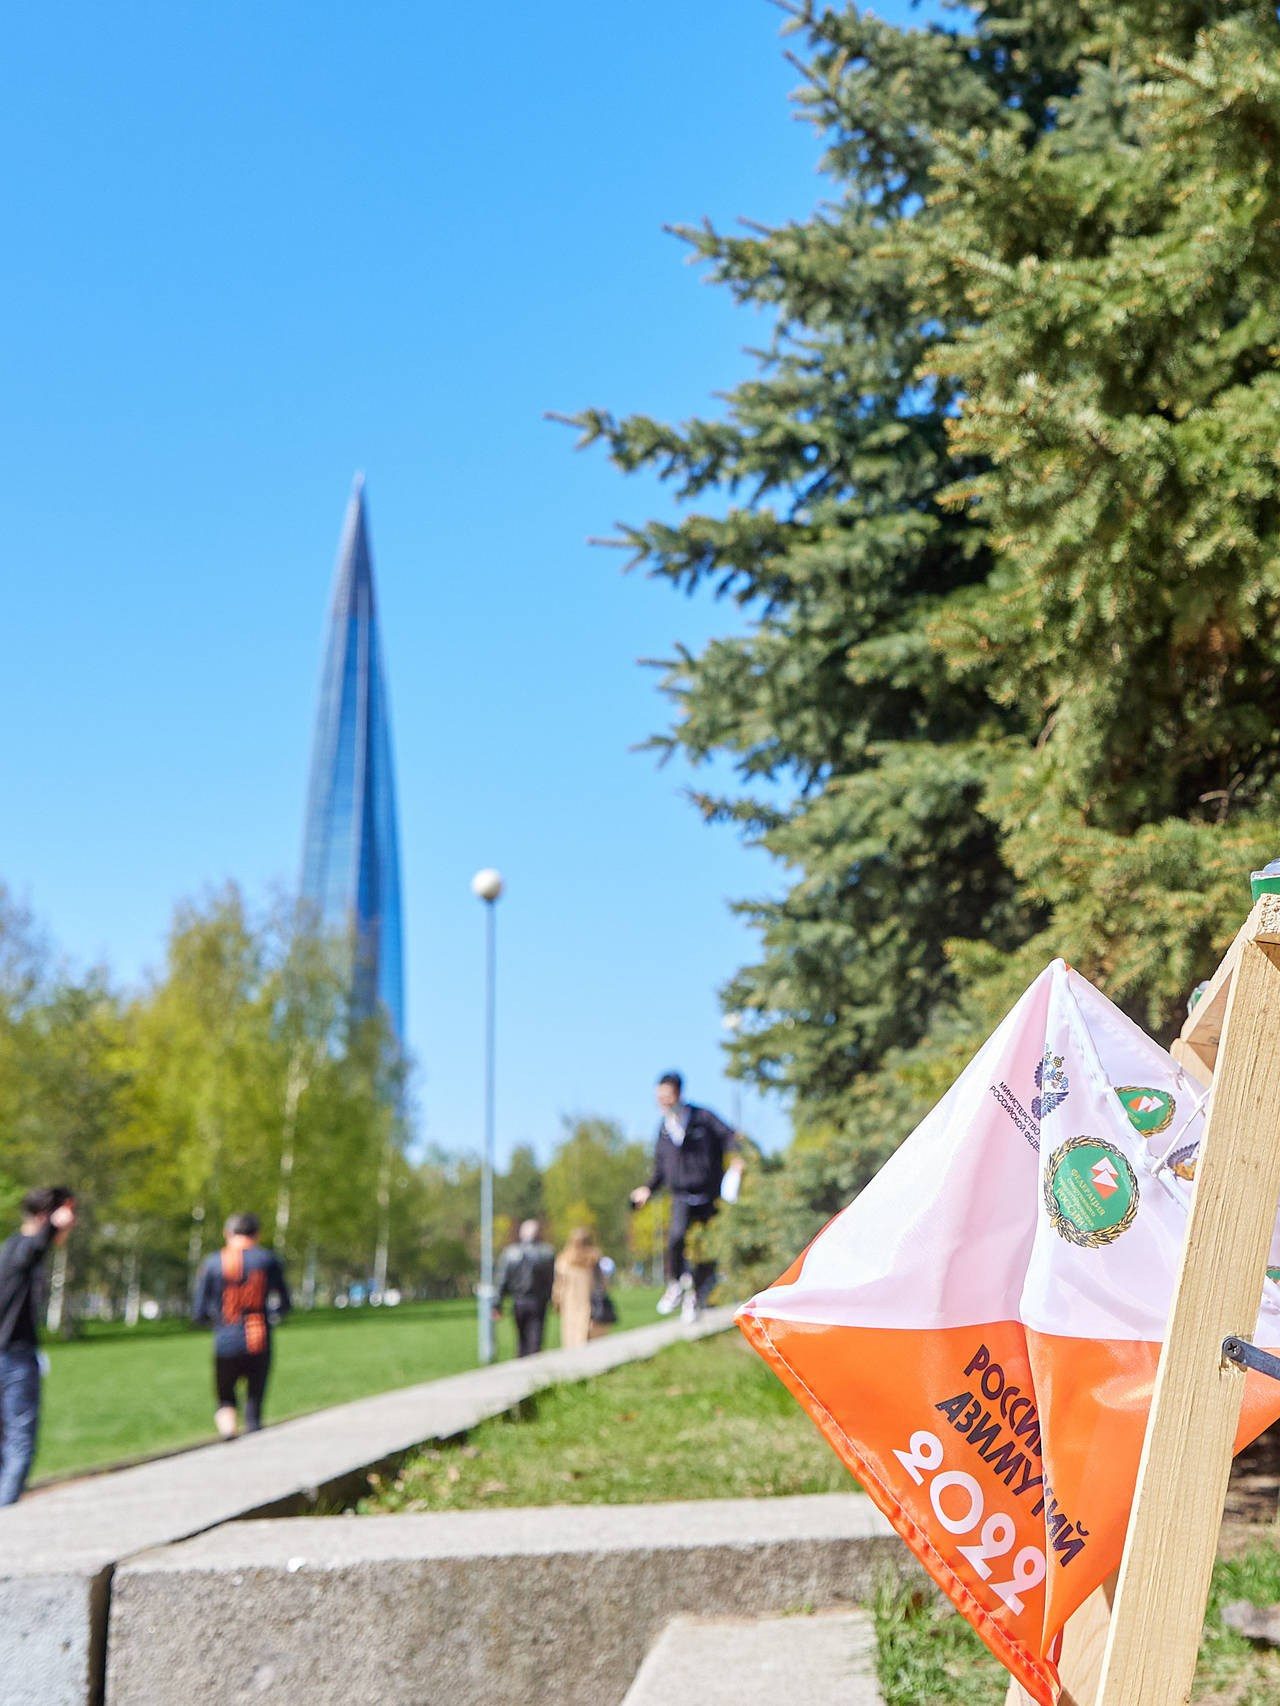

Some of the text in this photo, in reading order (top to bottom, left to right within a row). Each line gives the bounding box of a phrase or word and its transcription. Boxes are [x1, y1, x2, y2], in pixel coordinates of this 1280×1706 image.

[989, 1085, 1027, 1133] РОССИЙСКОЙ
[998, 1081, 1041, 1136] МИНИСТЕРСТВО
[1056, 1188, 1085, 1227] РОССИИ
[1071, 1168, 1106, 1216] ФЕДЕРАЦИЯ
[892, 1430, 1046, 1616] 2022
